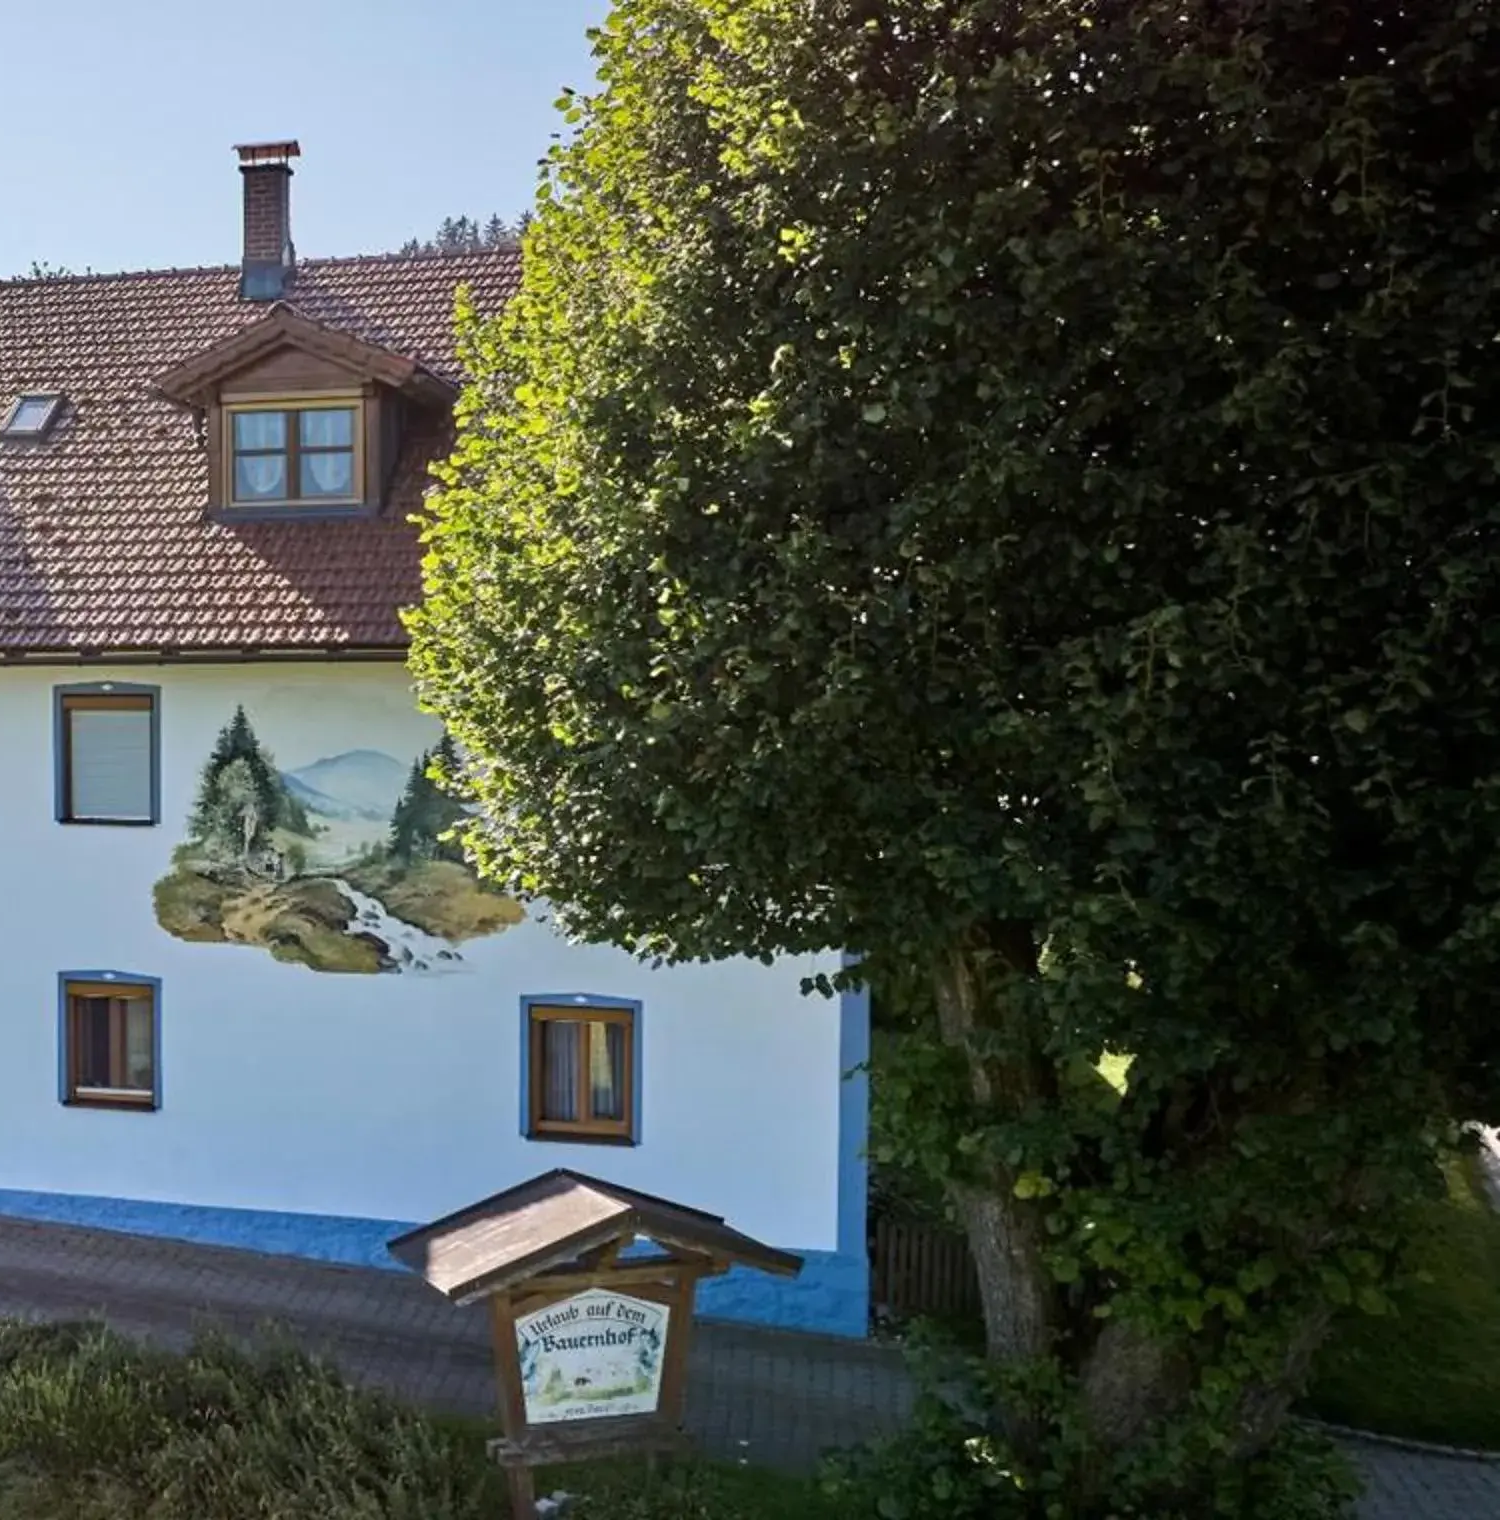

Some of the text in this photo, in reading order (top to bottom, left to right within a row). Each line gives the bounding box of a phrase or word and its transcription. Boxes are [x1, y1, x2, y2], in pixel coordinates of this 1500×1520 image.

[529, 1301, 646, 1335] Urlaub auf dem
[542, 1327, 637, 1353] Bauernhof
